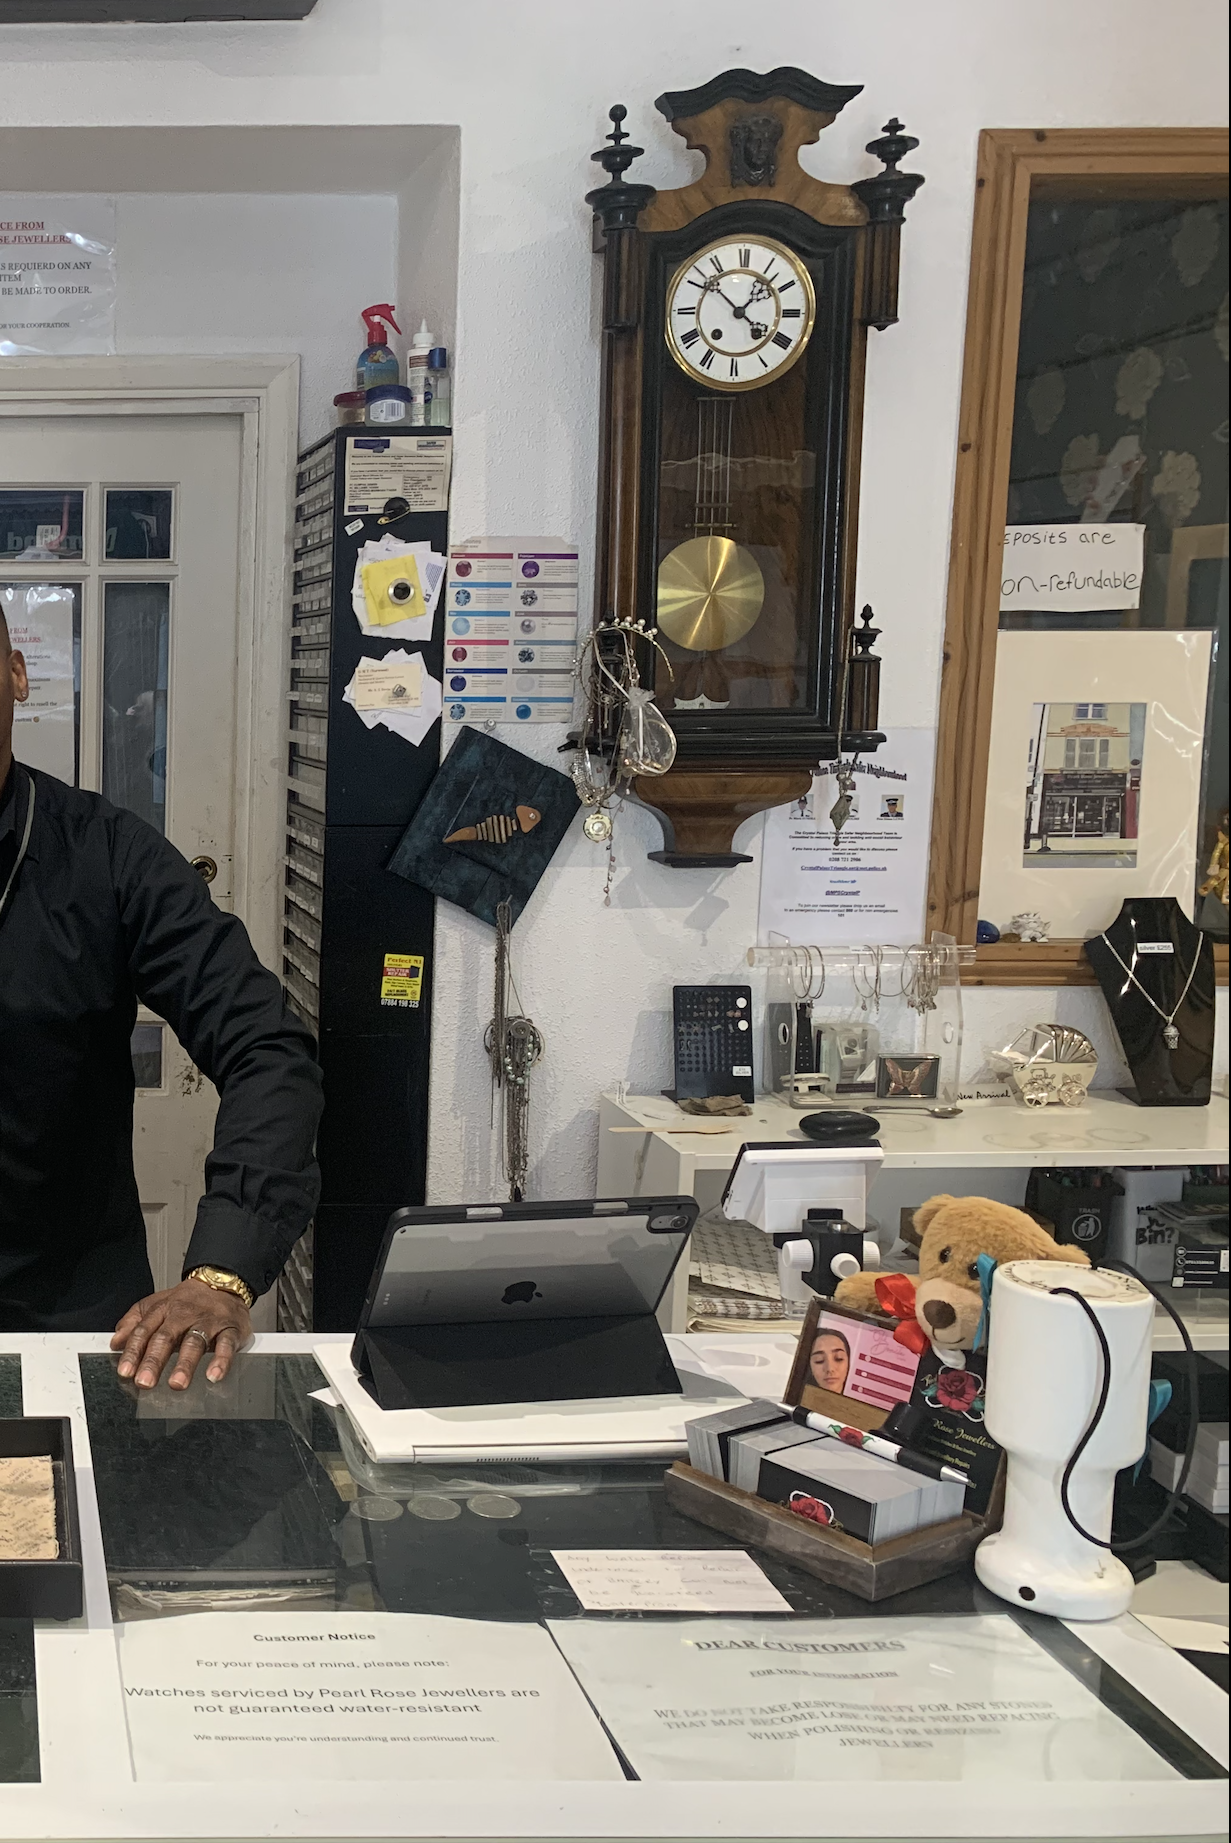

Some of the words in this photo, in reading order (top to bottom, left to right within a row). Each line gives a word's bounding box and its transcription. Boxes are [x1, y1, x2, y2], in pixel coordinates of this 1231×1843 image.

[16, 222, 45, 230] FROM
[43, 287, 56, 295] TO
[1079, 532, 1116, 545] are
[1001, 569, 1140, 596] on-refundable
[957, 1092, 973, 1100] New
[977, 1090, 1011, 1099] Arrival
[1136, 1227, 1175, 1246] Bin?
[932, 1418, 954, 1434] Rose
[955, 1428, 997, 1450] Jewellers
[253, 1634, 325, 1642] Customer
[328, 1633, 376, 1641] Notice
[693, 1640, 760, 1650] DEAR
[763, 1640, 906, 1653] CUSTOMERS
[196, 1660, 219, 1668] For
[222, 1662, 252, 1670] your
[256, 1662, 300, 1670] peace
[303, 1660, 316, 1668] of
[364, 1659, 410, 1669] please
[413, 1660, 450, 1668] note:
[125, 1687, 206, 1698] Watches
[211, 1687, 288, 1698] serviced
[293, 1687, 314, 1700] by
[319, 1687, 366, 1698] Pearl
[371, 1688, 416, 1698] Rose
[421, 1687, 506, 1698] Jewellers
[511, 1689, 540, 1697] are
[194, 1704, 224, 1714] not
[229, 1703, 334, 1716] guaranteed
[339, 1703, 482, 1713] water-resistant
[654, 1709, 681, 1720] WE
[748, 1704, 792, 1716] TAKE
[919, 1704, 955, 1713] FOR
[956, 1703, 986, 1711] ANY
[664, 1720, 706, 1730] THAT
[750, 1712, 821, 1727] BECOME
[822, 1710, 863, 1721] LOSE
[214, 1735, 271, 1743] appreciate
[747, 1730, 800, 1741] WHEN
[803, 1724, 894, 1736] POLISHING
